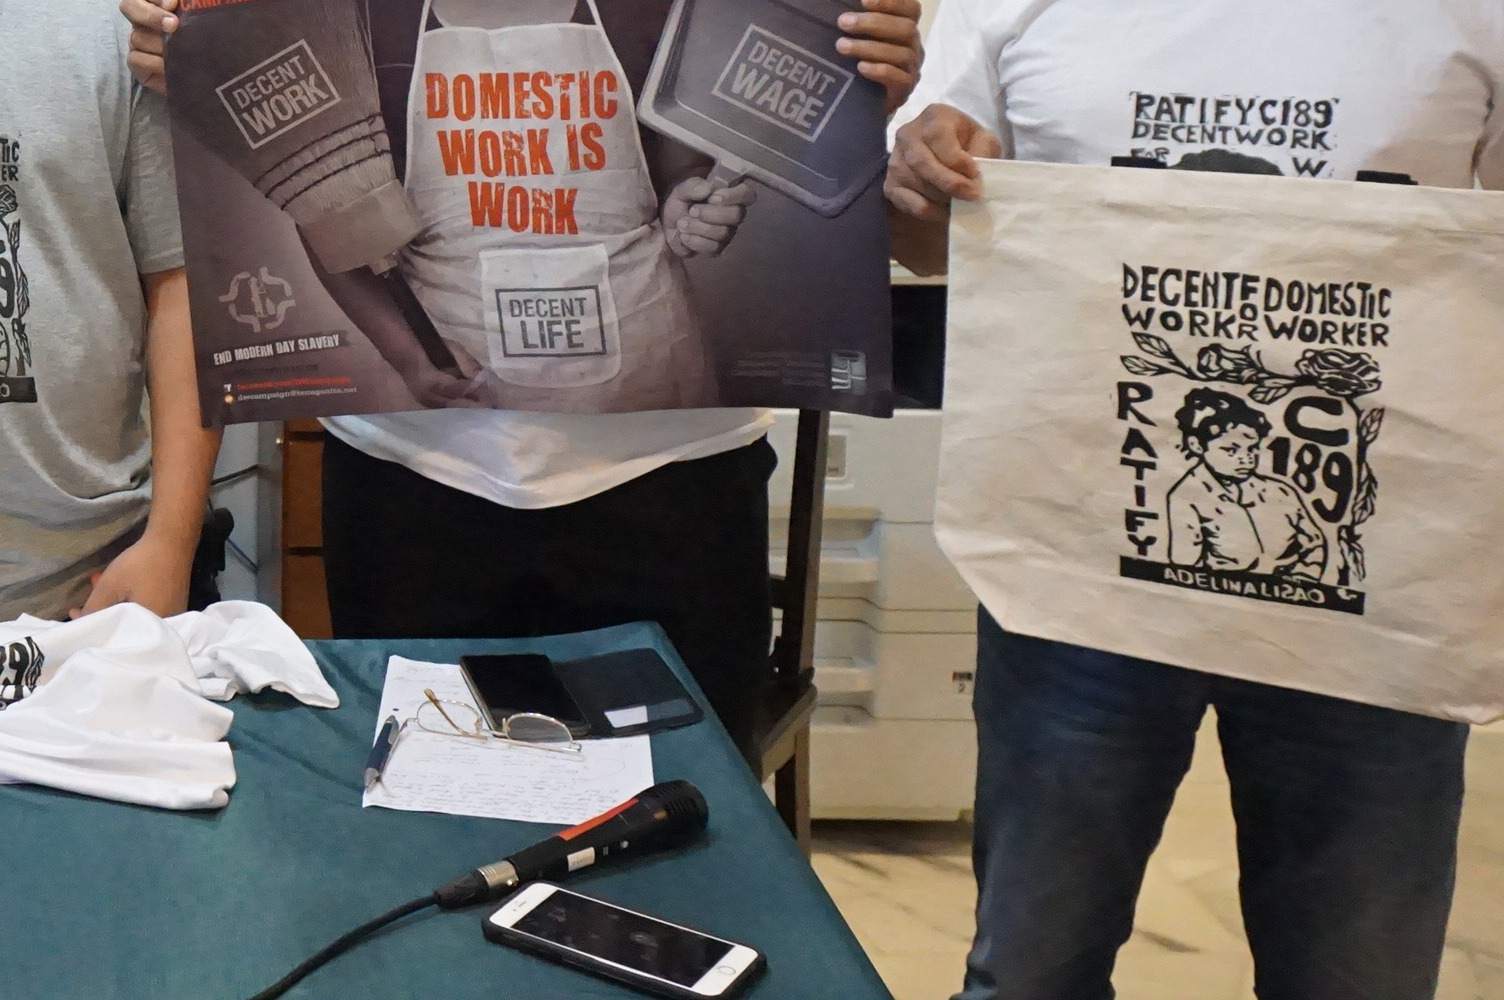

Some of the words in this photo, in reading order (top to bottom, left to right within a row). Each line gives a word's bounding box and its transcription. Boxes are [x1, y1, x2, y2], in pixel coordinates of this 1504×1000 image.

[232, 55, 306, 109] DECENT
[748, 40, 836, 95] DECENT
[242, 73, 330, 136] WORK
[425, 70, 618, 121] DOMESTIC
[731, 63, 825, 129] WAGE
[437, 128, 554, 177] WORK
[566, 122, 606, 171] IS
[468, 182, 578, 234] WORK
[509, 297, 587, 318] DECENT
[1121, 262, 1240, 309] DECENT
[1263, 277, 1392, 319] DOMESTIC
[214, 351, 233, 365] END
[234, 344, 274, 361] MODERN
[275, 340, 295, 354] DAY
[298, 334, 340, 351] SLAVERY
[520, 319, 585, 349] LIFE
[1121, 304, 1236, 339] WORK
[1263, 314, 1389, 347] WORKER
[1117, 381, 1158, 556] RATIFY
